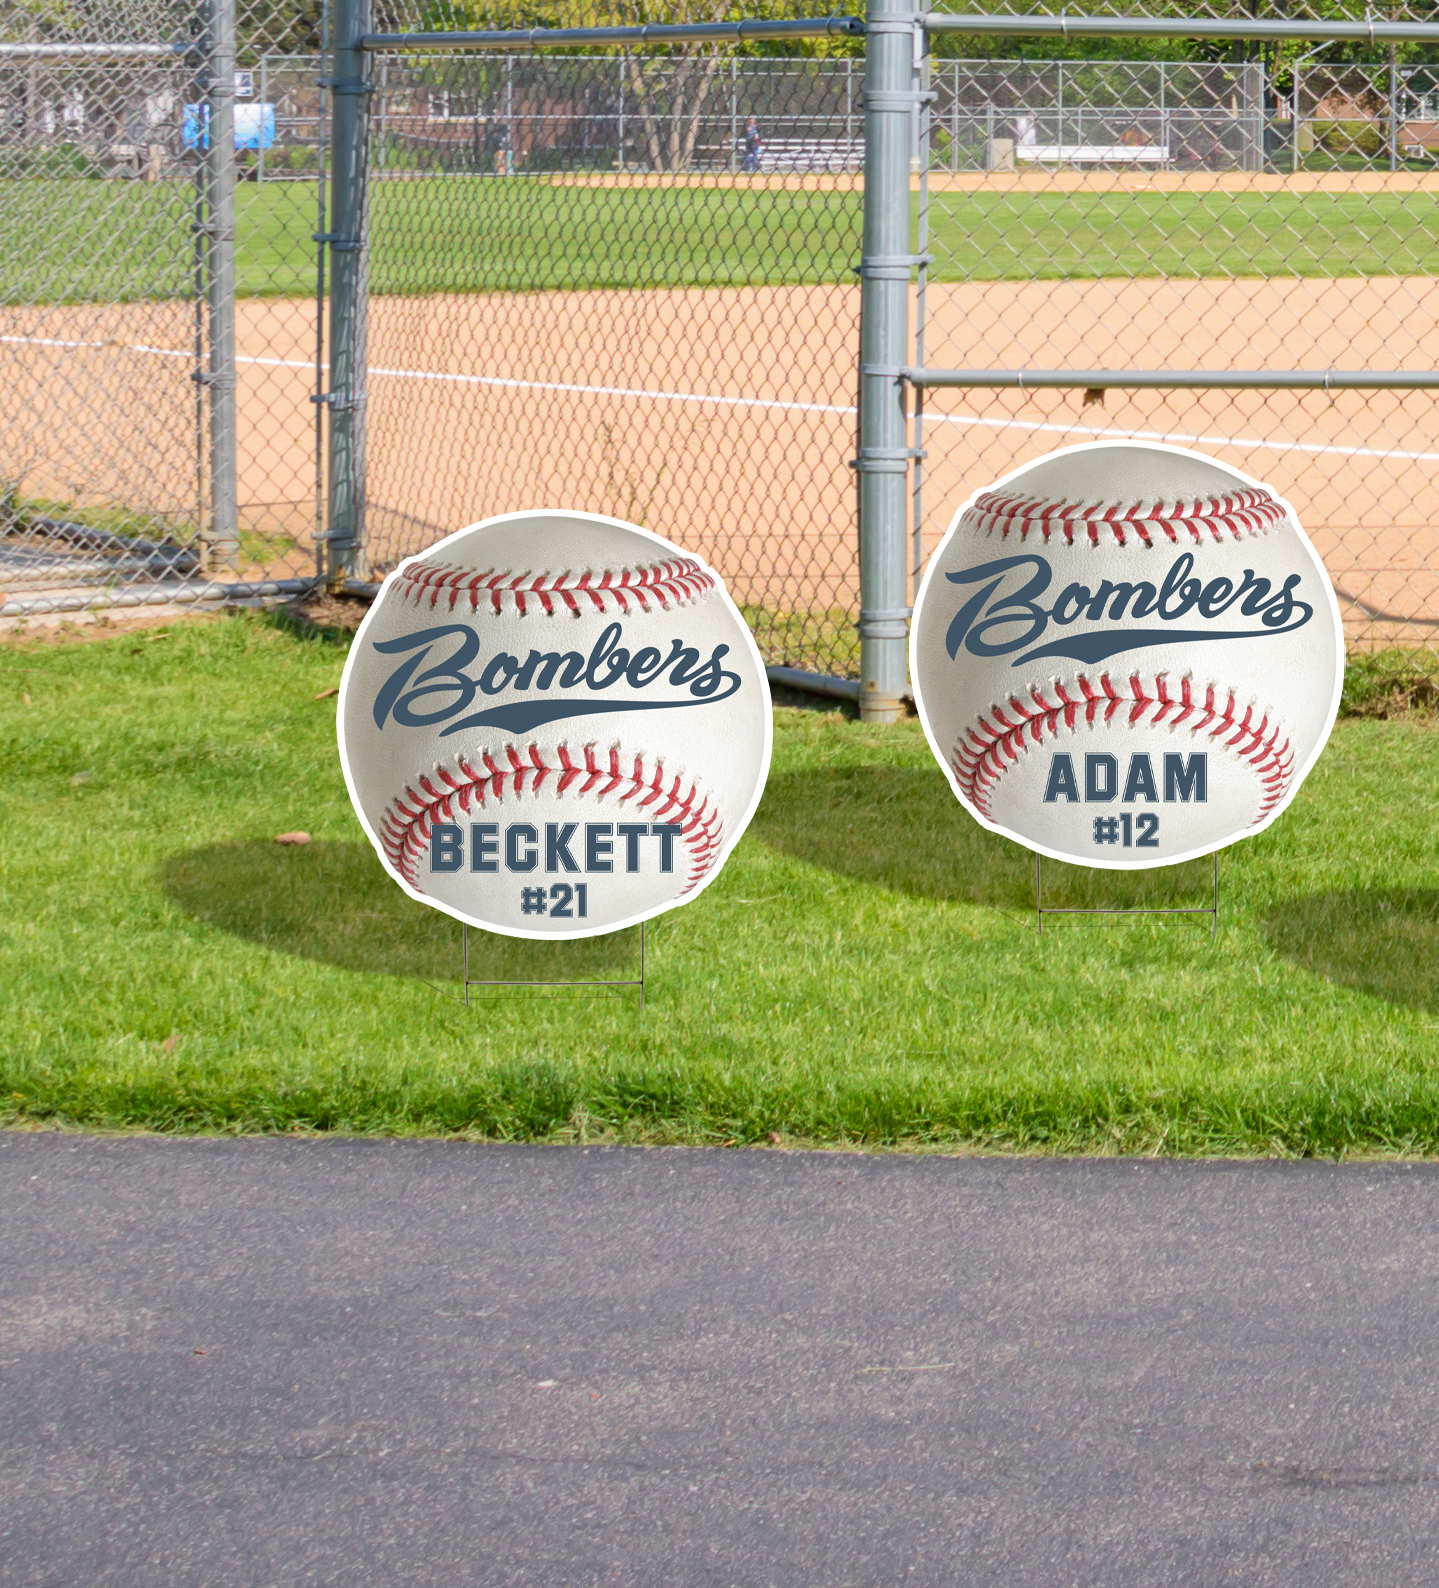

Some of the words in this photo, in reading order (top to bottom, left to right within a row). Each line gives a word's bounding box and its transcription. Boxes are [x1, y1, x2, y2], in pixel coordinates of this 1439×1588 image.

[945, 552, 1313, 667] Bombers
[372, 622, 741, 737] Bombers
[1043, 752, 1208, 803] ADAM
[430, 823, 683, 874] BECKETT
[1093, 812, 1160, 848] #12
[521, 882, 588, 918] #21
